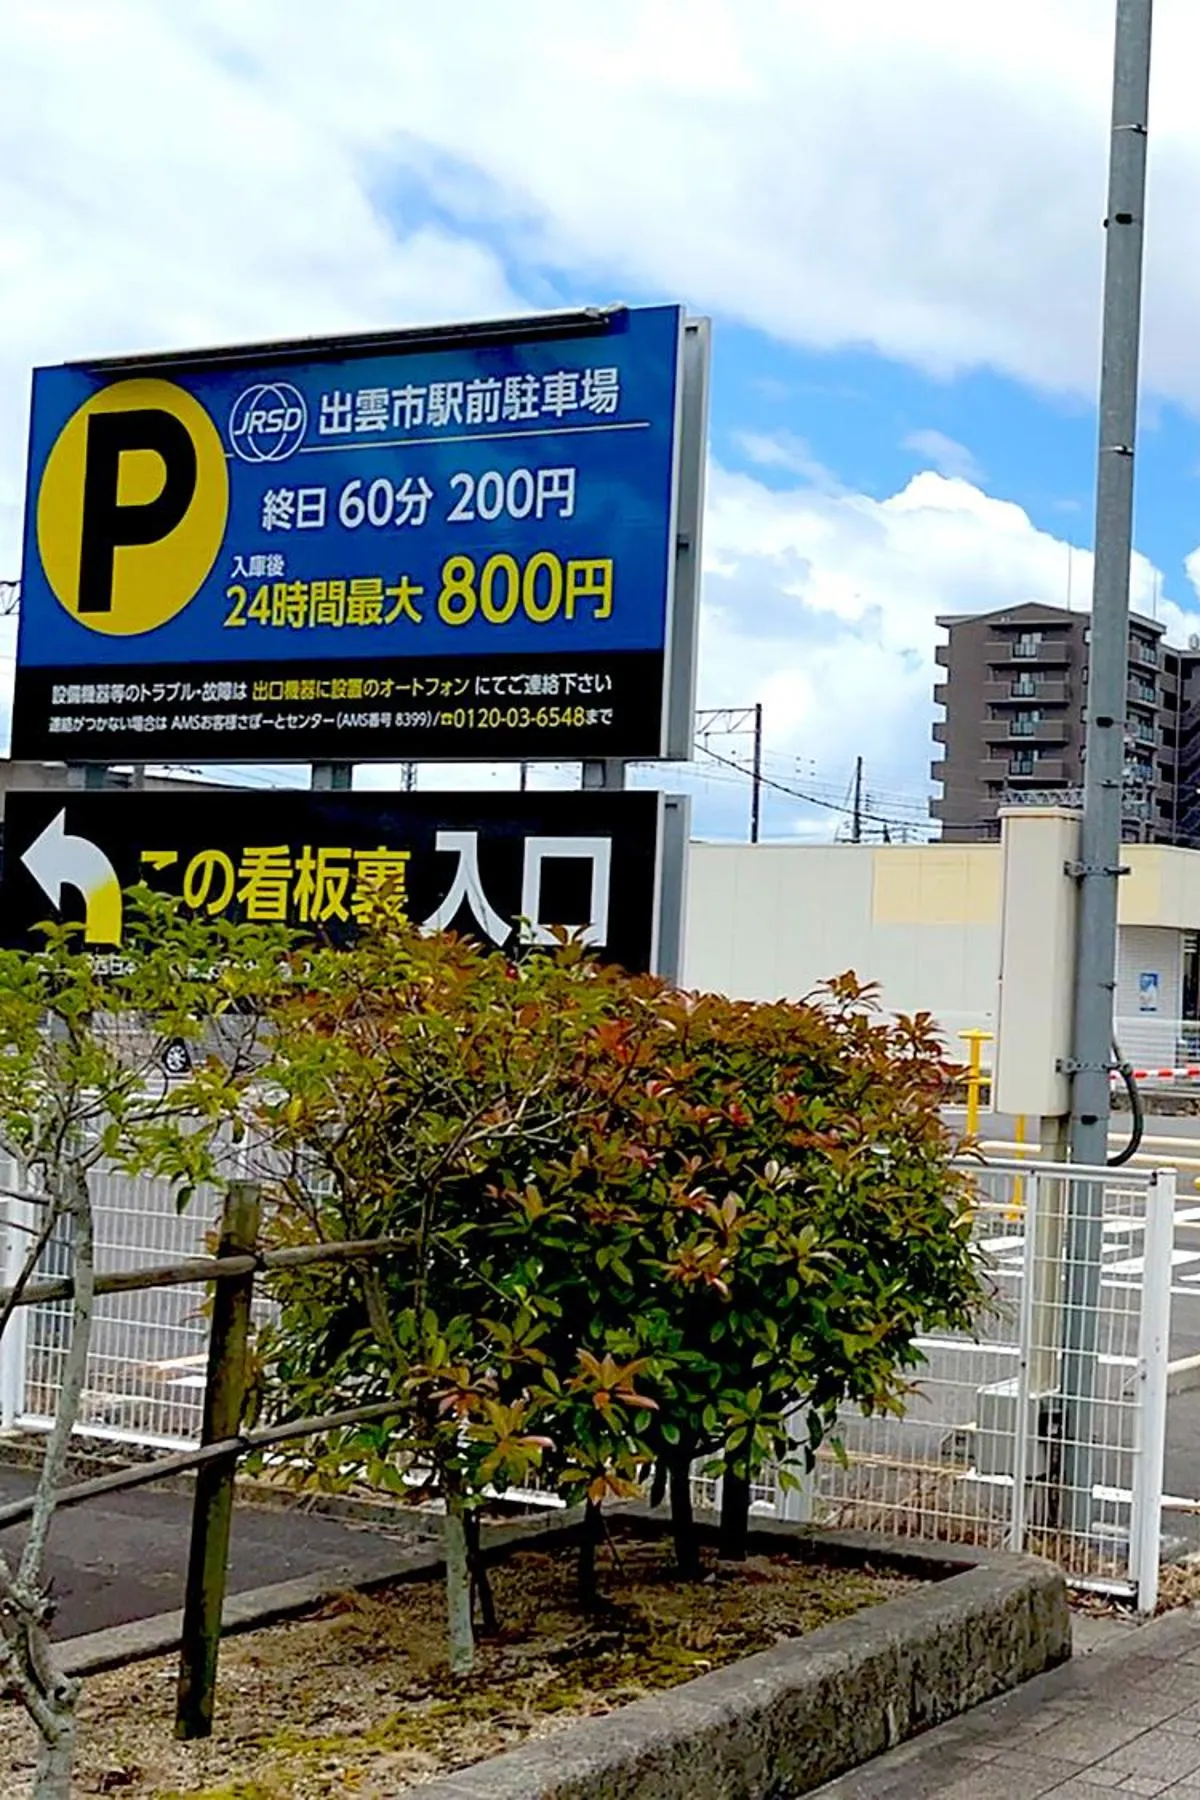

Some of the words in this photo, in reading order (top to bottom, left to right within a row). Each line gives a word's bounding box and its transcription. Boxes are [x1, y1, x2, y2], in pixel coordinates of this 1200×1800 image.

[233, 406, 303, 437] JRSD
[319, 367, 620, 436] 出雲市駅前駐車場
[77, 408, 198, 613] P
[262, 487, 327, 532] 終日
[339, 476, 434, 529] 60分
[447, 467, 576, 522] 200円
[223, 575, 423, 629] 24時間最大
[438, 551, 614, 626] 800円
[230, 554, 286, 579] 入庫後
[417, 831, 612, 948] 入口
